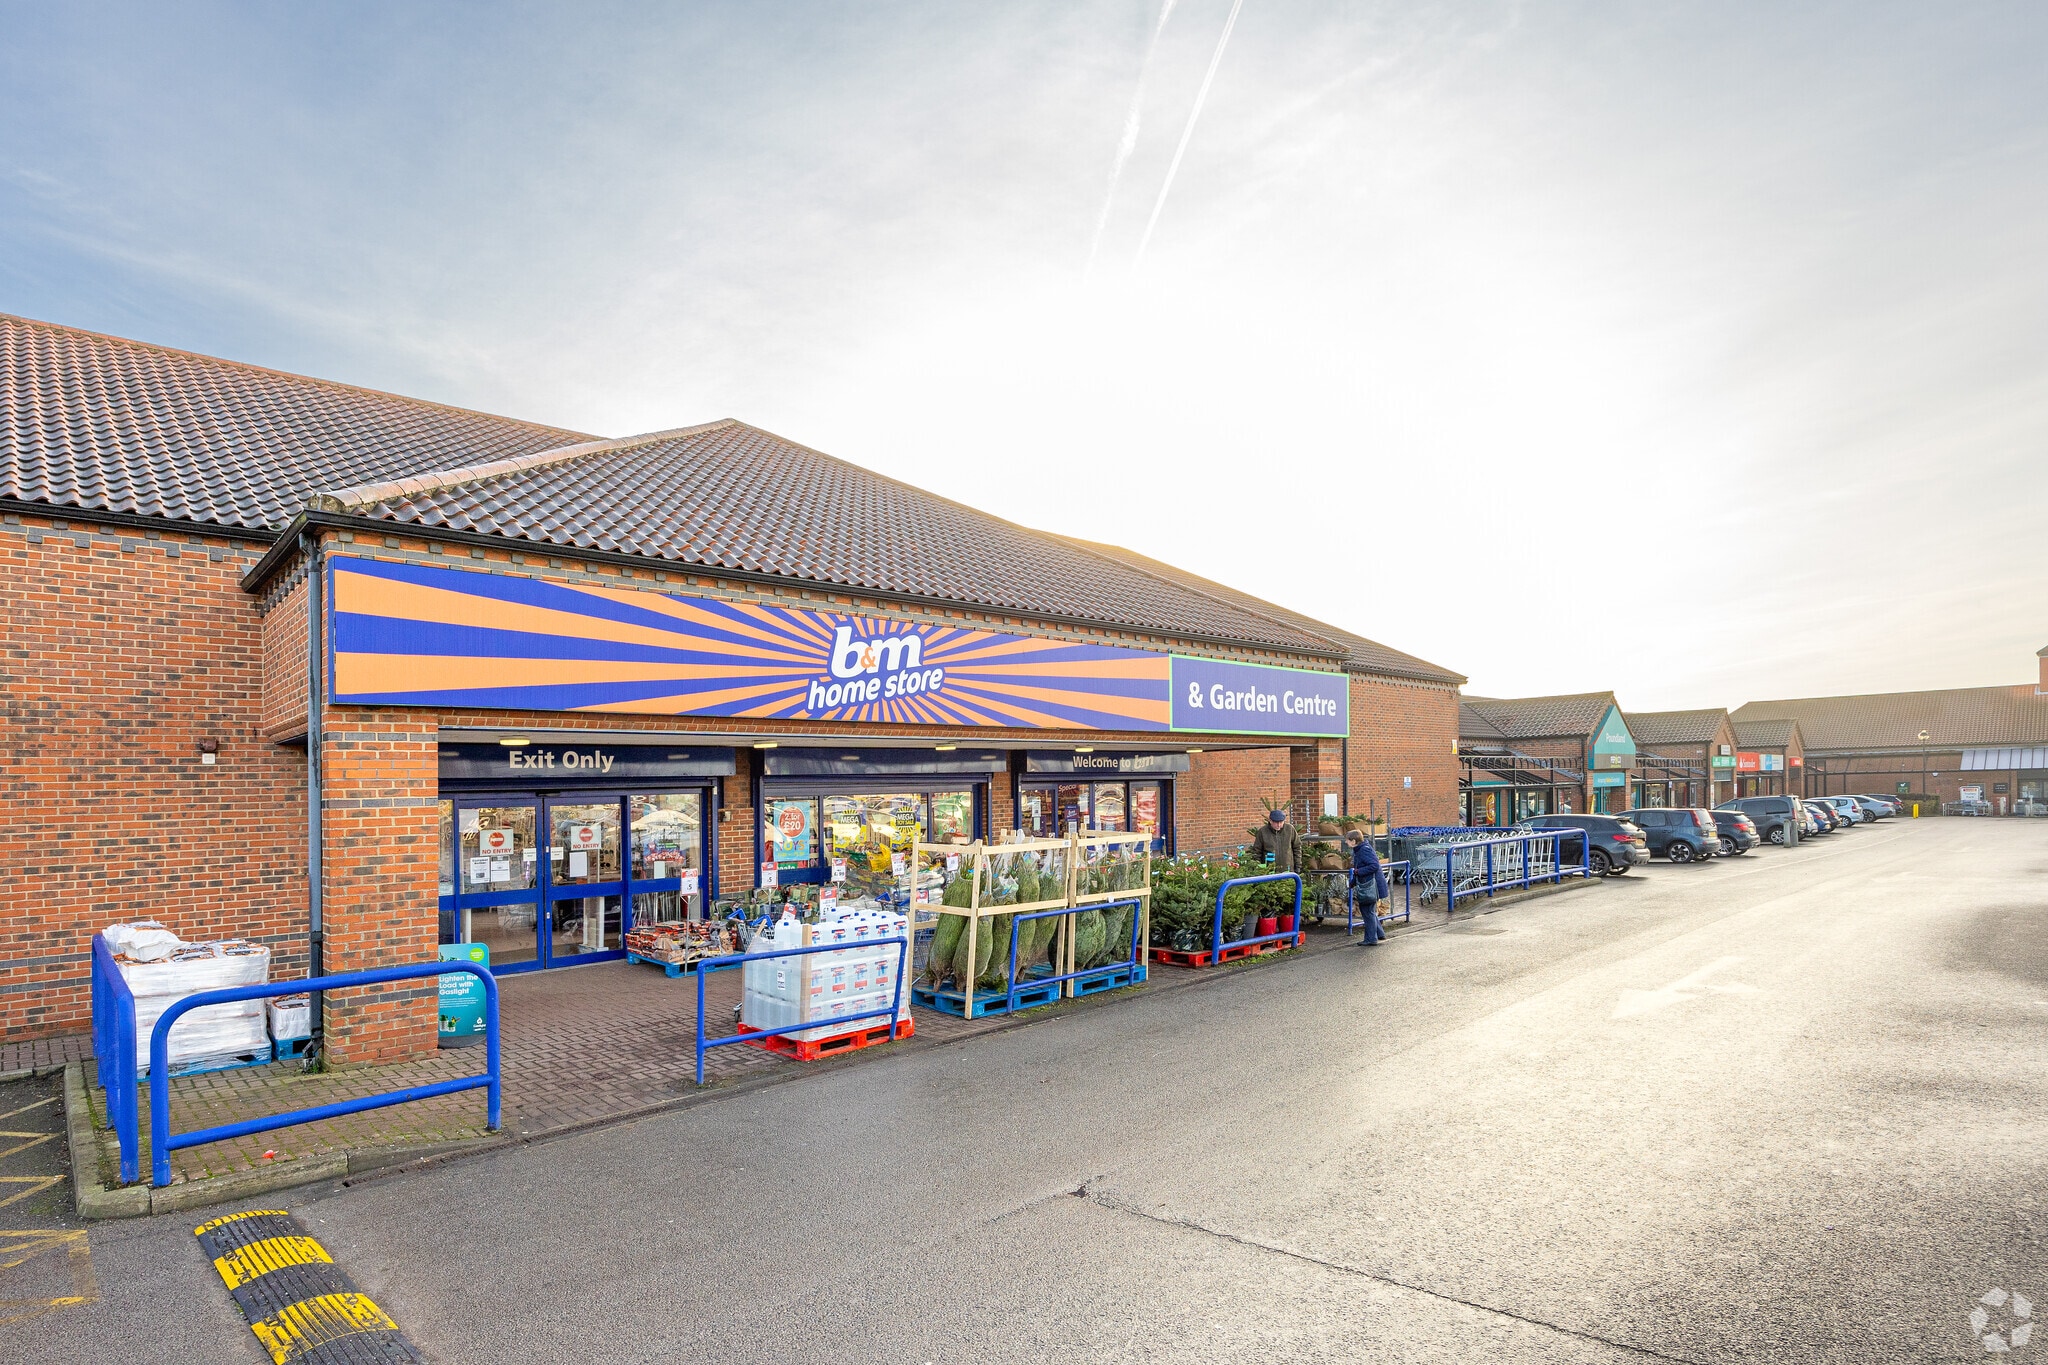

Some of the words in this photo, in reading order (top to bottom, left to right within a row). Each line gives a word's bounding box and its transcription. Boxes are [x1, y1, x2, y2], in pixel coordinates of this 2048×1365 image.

[808, 678, 881, 710] home
[885, 668, 943, 698] store
[1188, 681, 1204, 709] &
[1209, 683, 1277, 713] Garden
[1283, 690, 1337, 717] Centre
[509, 749, 555, 769] Exit
[562, 750, 615, 773] Only
[1073, 755, 1118, 768] Welcome
[1121, 757, 1131, 768] to
[840, 815, 859, 823] MEGA
[784, 821, 801, 831] £20
[779, 840, 805, 851] TOYS
[439, 975, 464, 983] Lighten
[439, 981, 457, 989] Load
[439, 987, 469, 996] Gaslight
